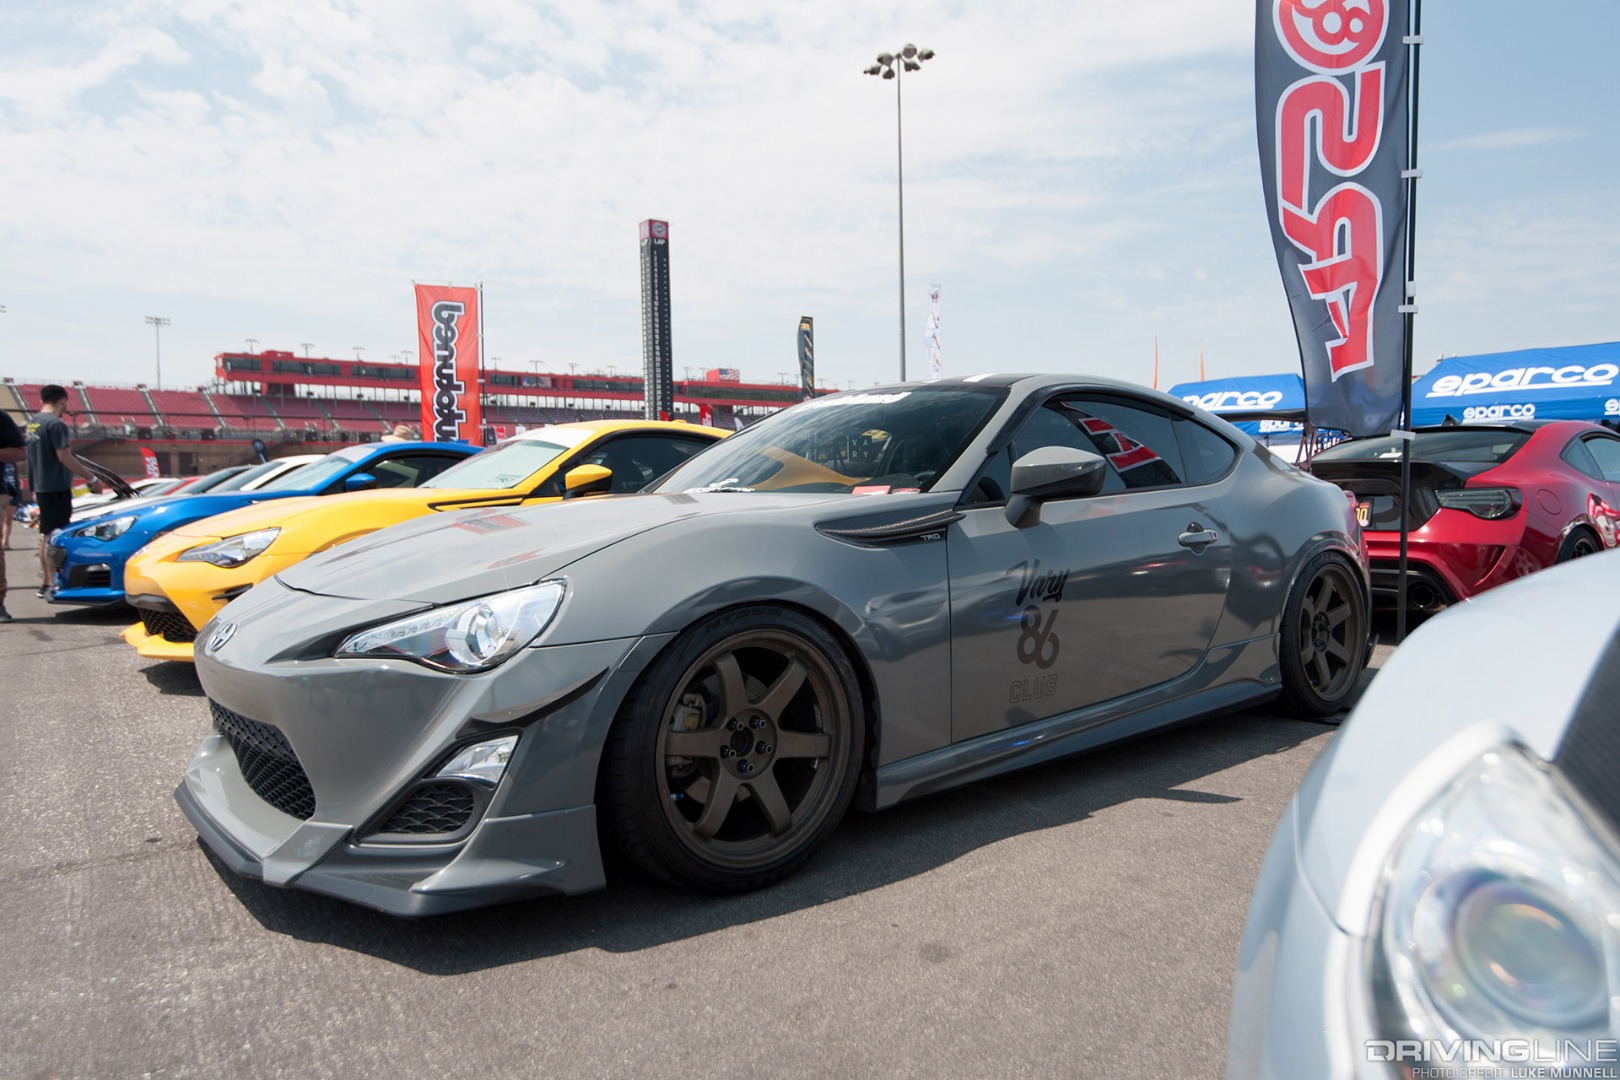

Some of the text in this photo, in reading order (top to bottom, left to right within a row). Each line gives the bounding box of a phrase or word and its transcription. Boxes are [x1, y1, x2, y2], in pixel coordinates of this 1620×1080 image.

[1426, 363, 1619, 398] sparco
[1463, 403, 1535, 423] sparco
[920, 533, 941, 541] TRD
[1008, 558, 1071, 606] Vary
[1017, 604, 1060, 670] 86
[1008, 674, 1059, 704] CLUB
